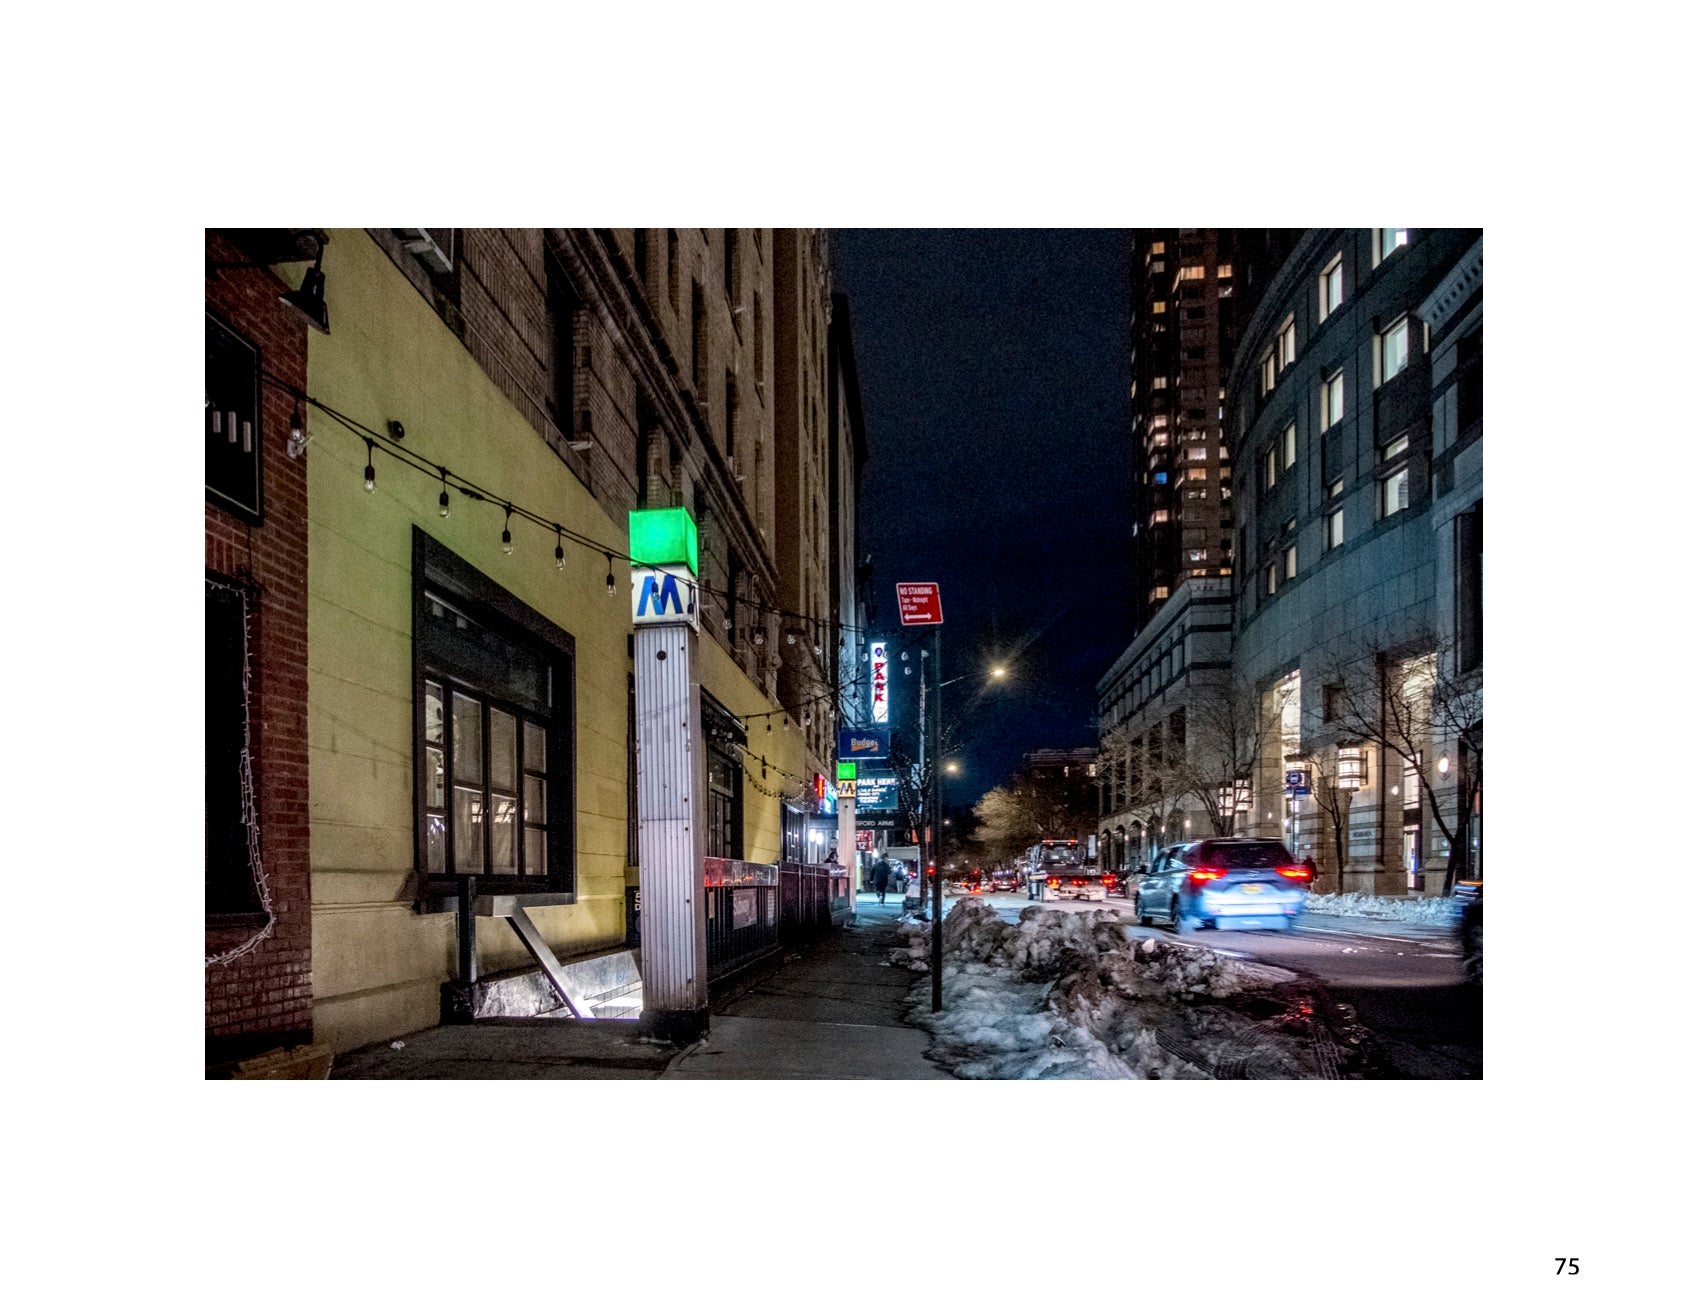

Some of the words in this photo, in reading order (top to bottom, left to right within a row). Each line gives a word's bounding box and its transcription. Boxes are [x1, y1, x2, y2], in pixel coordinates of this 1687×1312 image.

[636, 574, 684, 617] M
[899, 586, 908, 596] NO
[908, 586, 933, 596] STANDING
[874, 662, 885, 702] PARK
[840, 782, 855, 795] M
[857, 778, 876, 786] PARK
